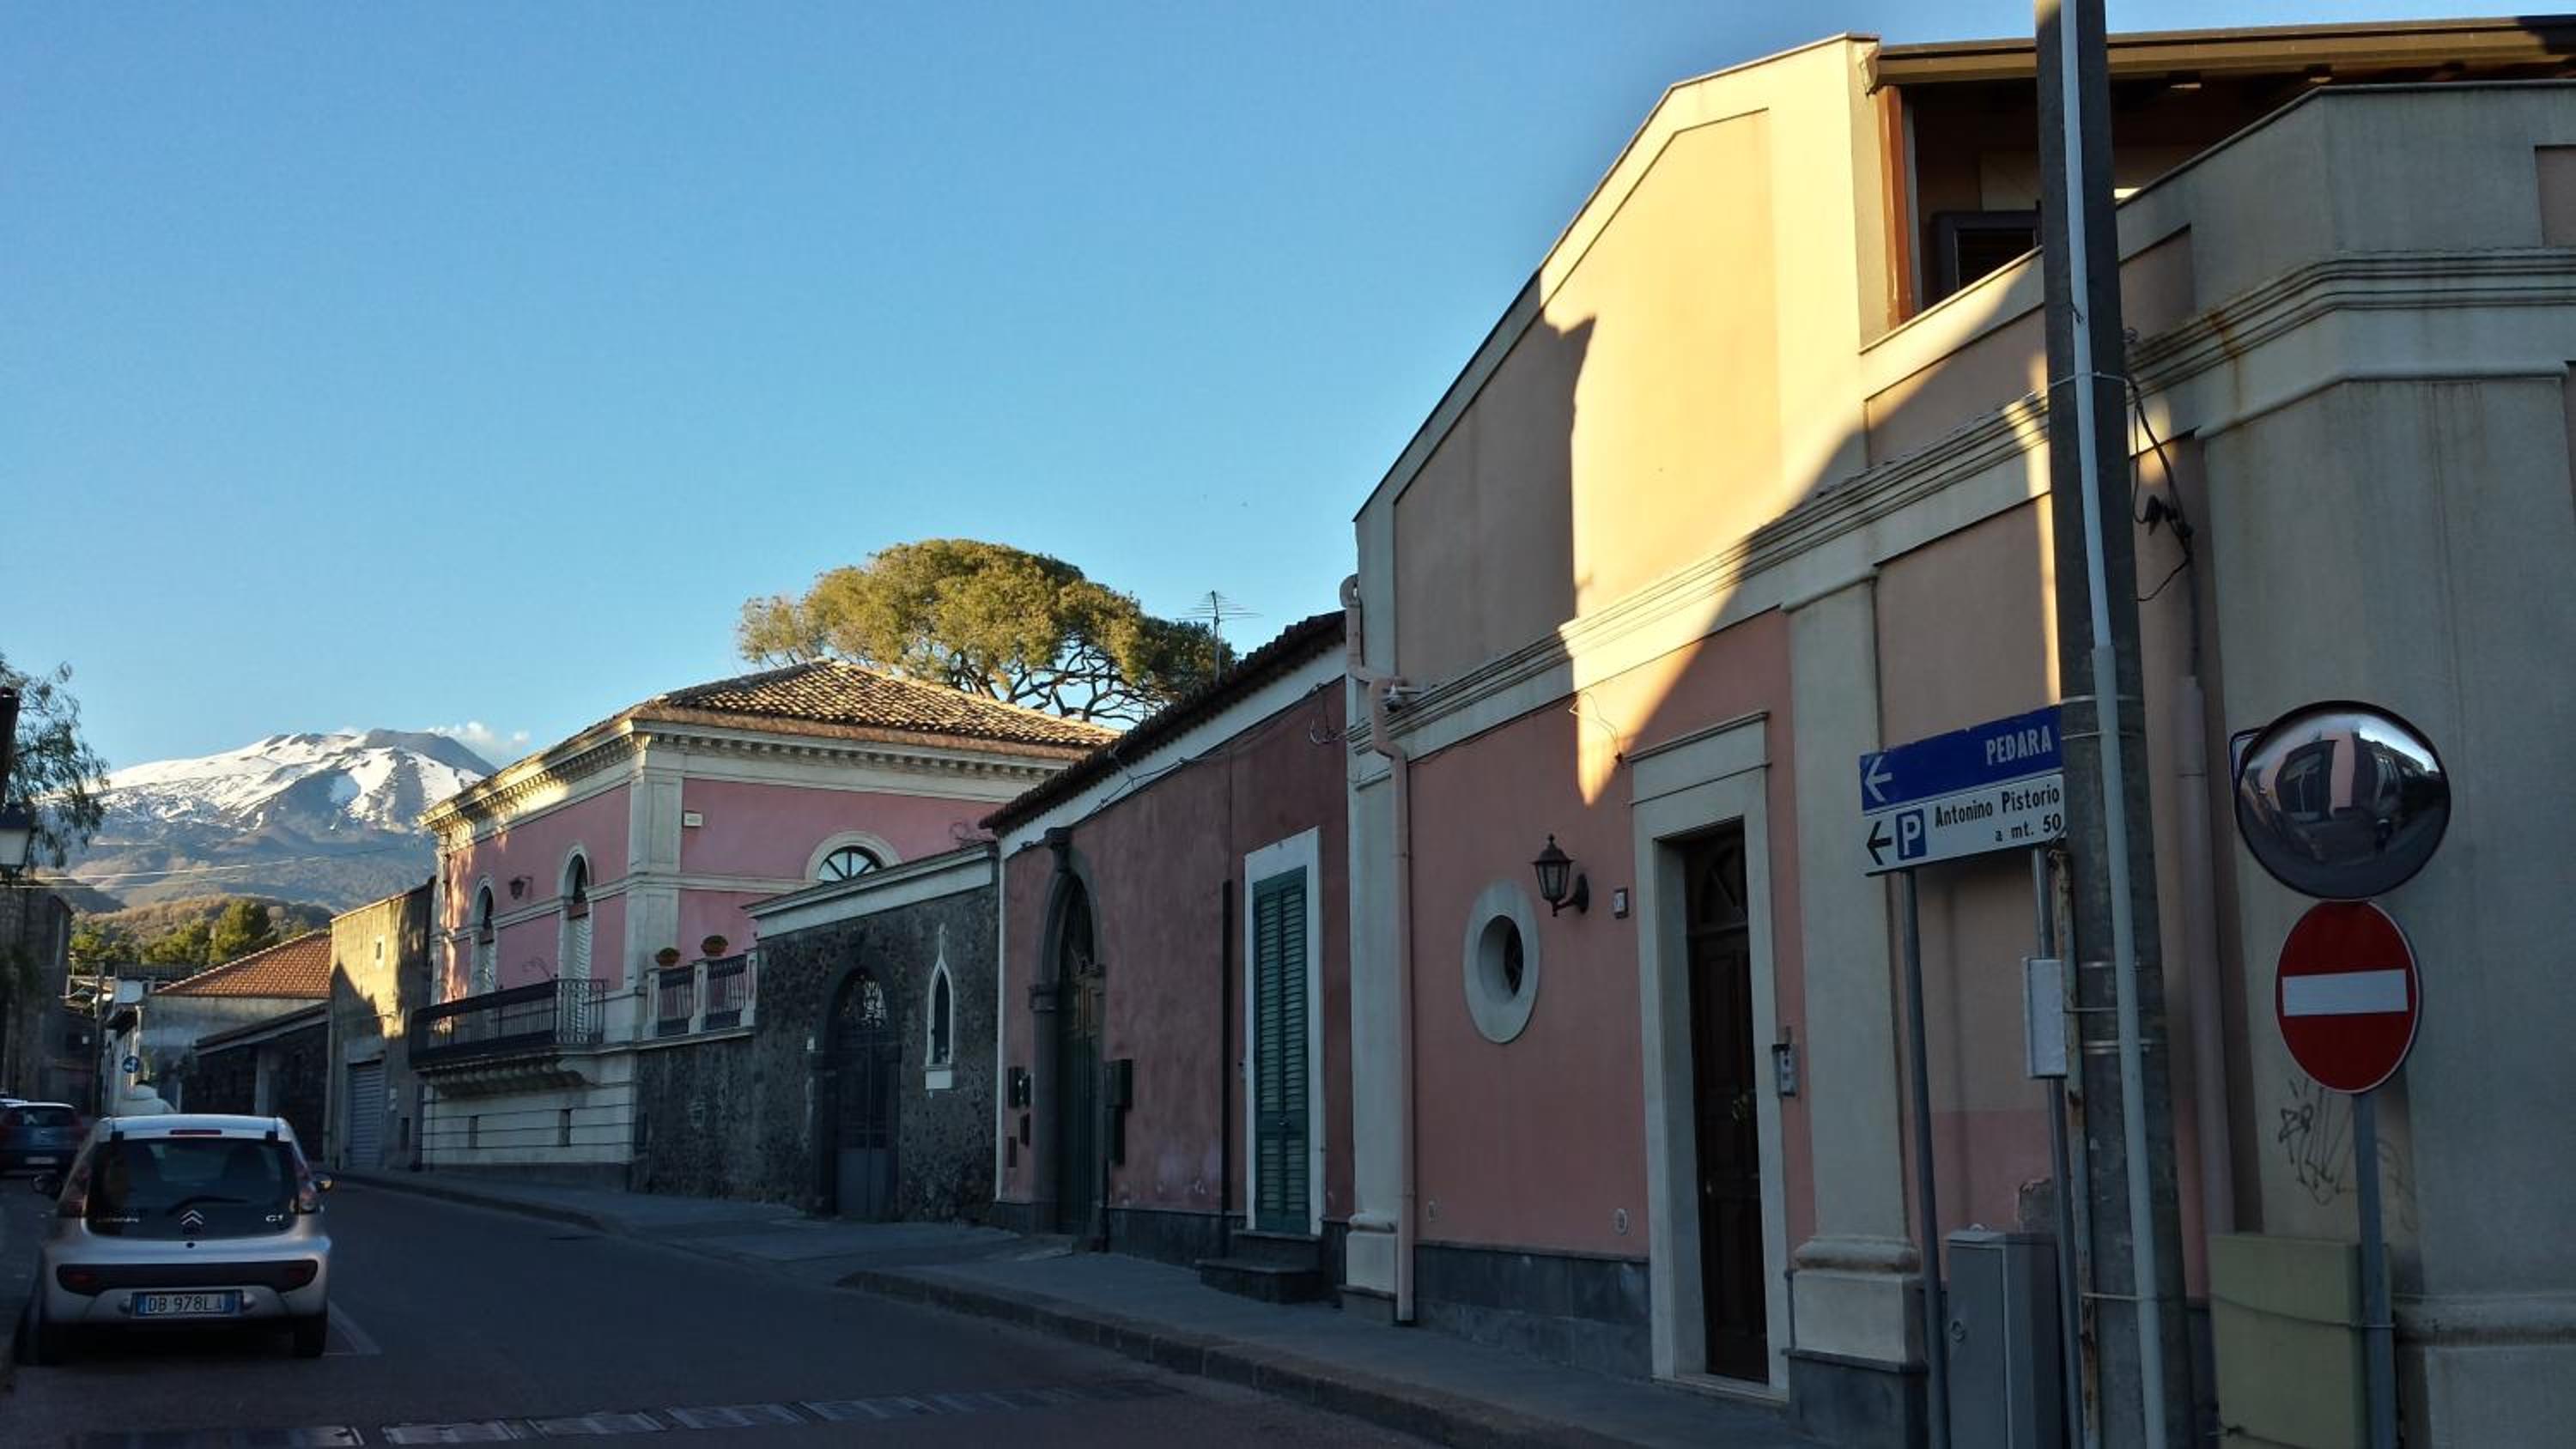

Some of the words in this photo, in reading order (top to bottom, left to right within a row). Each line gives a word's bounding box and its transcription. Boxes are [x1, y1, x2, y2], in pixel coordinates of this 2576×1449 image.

[1985, 725, 2053, 766] PEDARA
[1935, 800, 1993, 828] Antonino
[2002, 784, 2060, 814] Pistorio
[1900, 814, 1921, 856] P
[1995, 829, 2003, 842] a
[2011, 822, 2034, 840] mt.
[2043, 813, 2062, 834] 50
